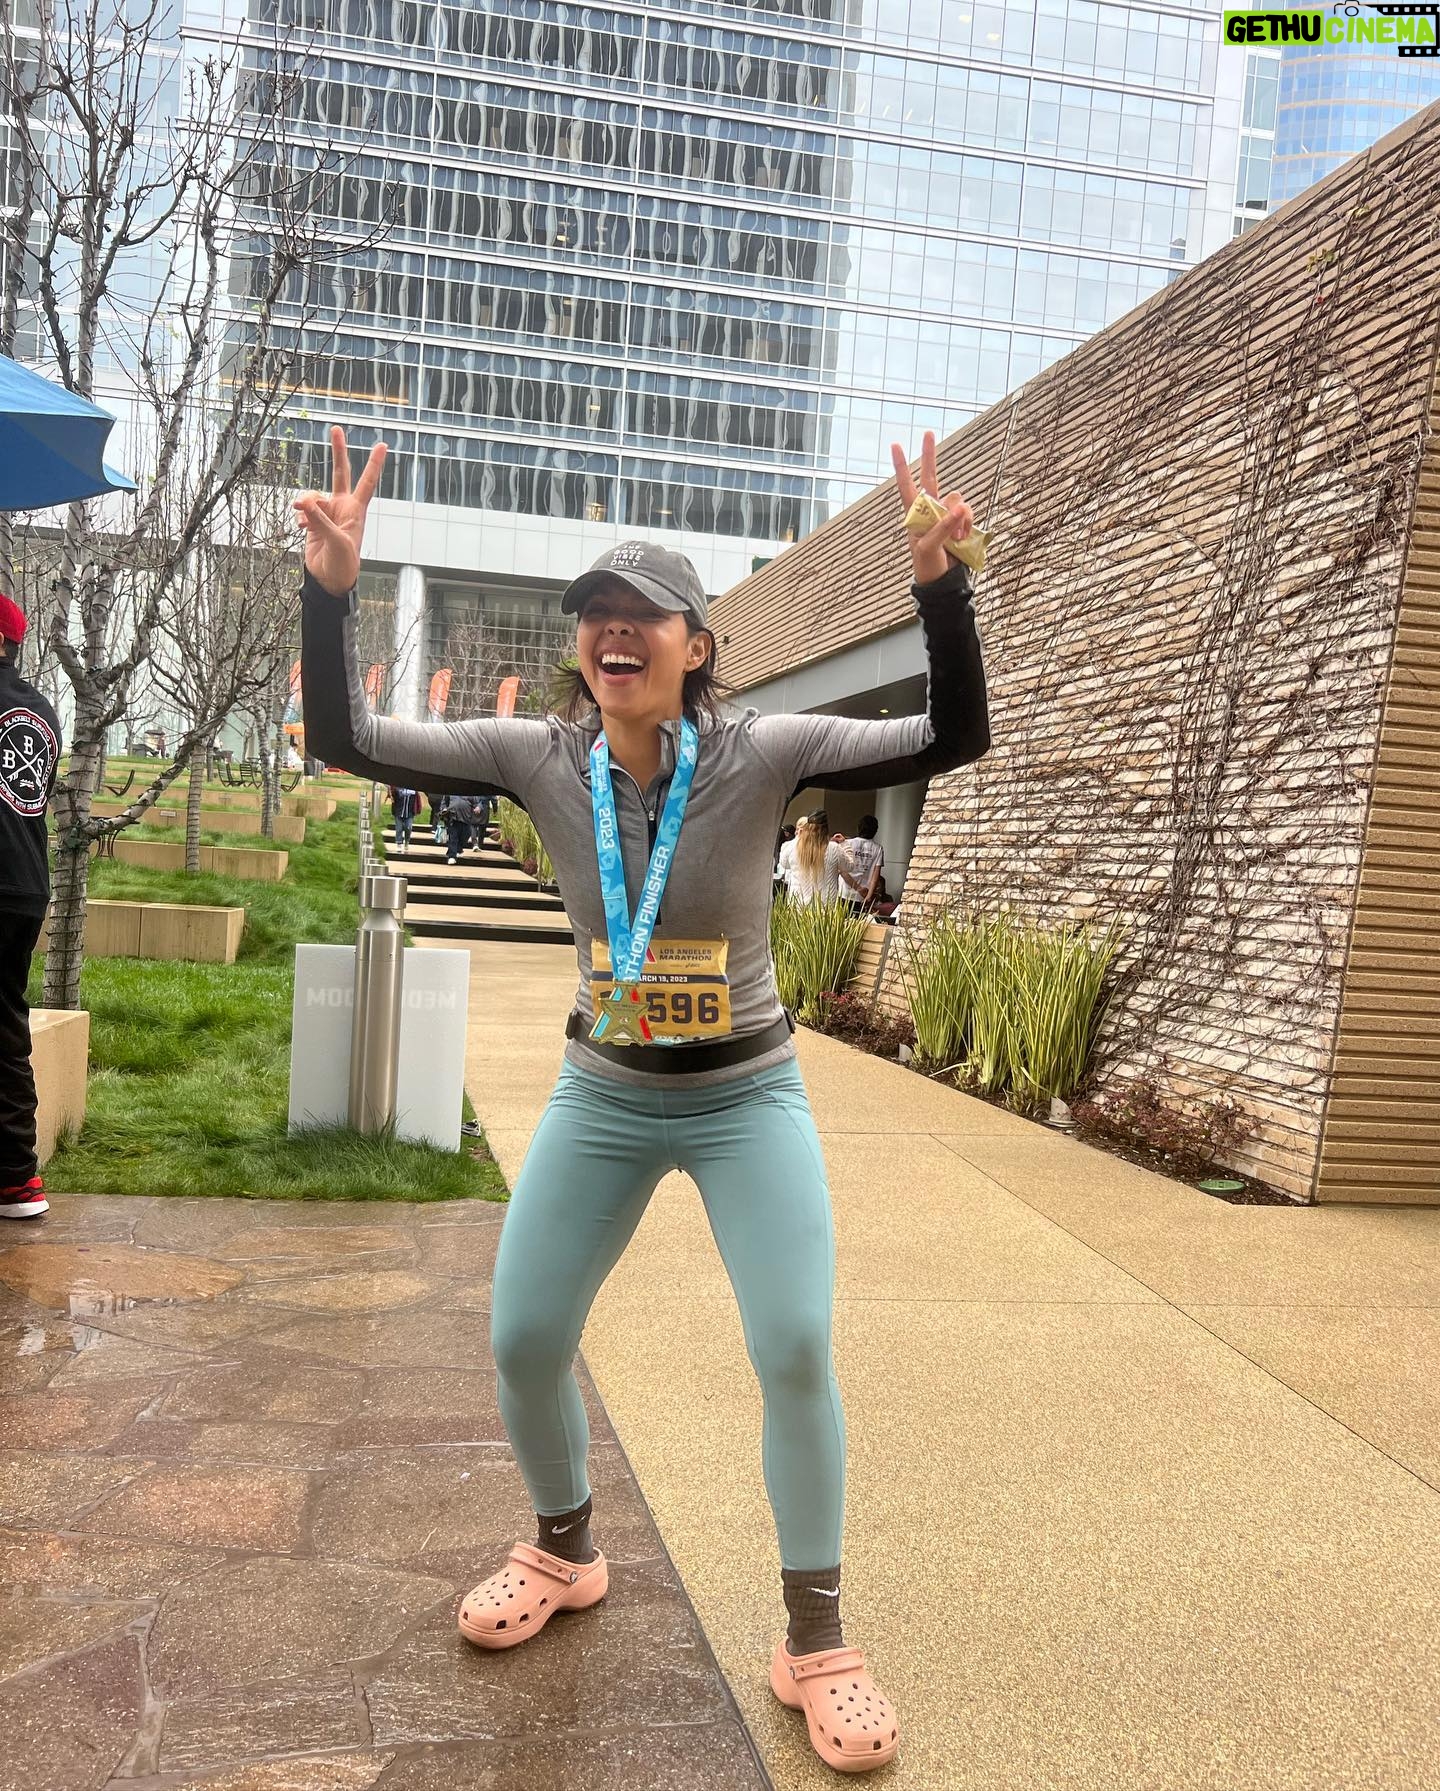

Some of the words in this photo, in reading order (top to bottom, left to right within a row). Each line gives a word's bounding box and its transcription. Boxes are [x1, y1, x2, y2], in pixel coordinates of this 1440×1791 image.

[598, 807, 615, 850] 2023
[639, 845, 670, 924] FINISHER
[600, 991, 719, 1024] 596
